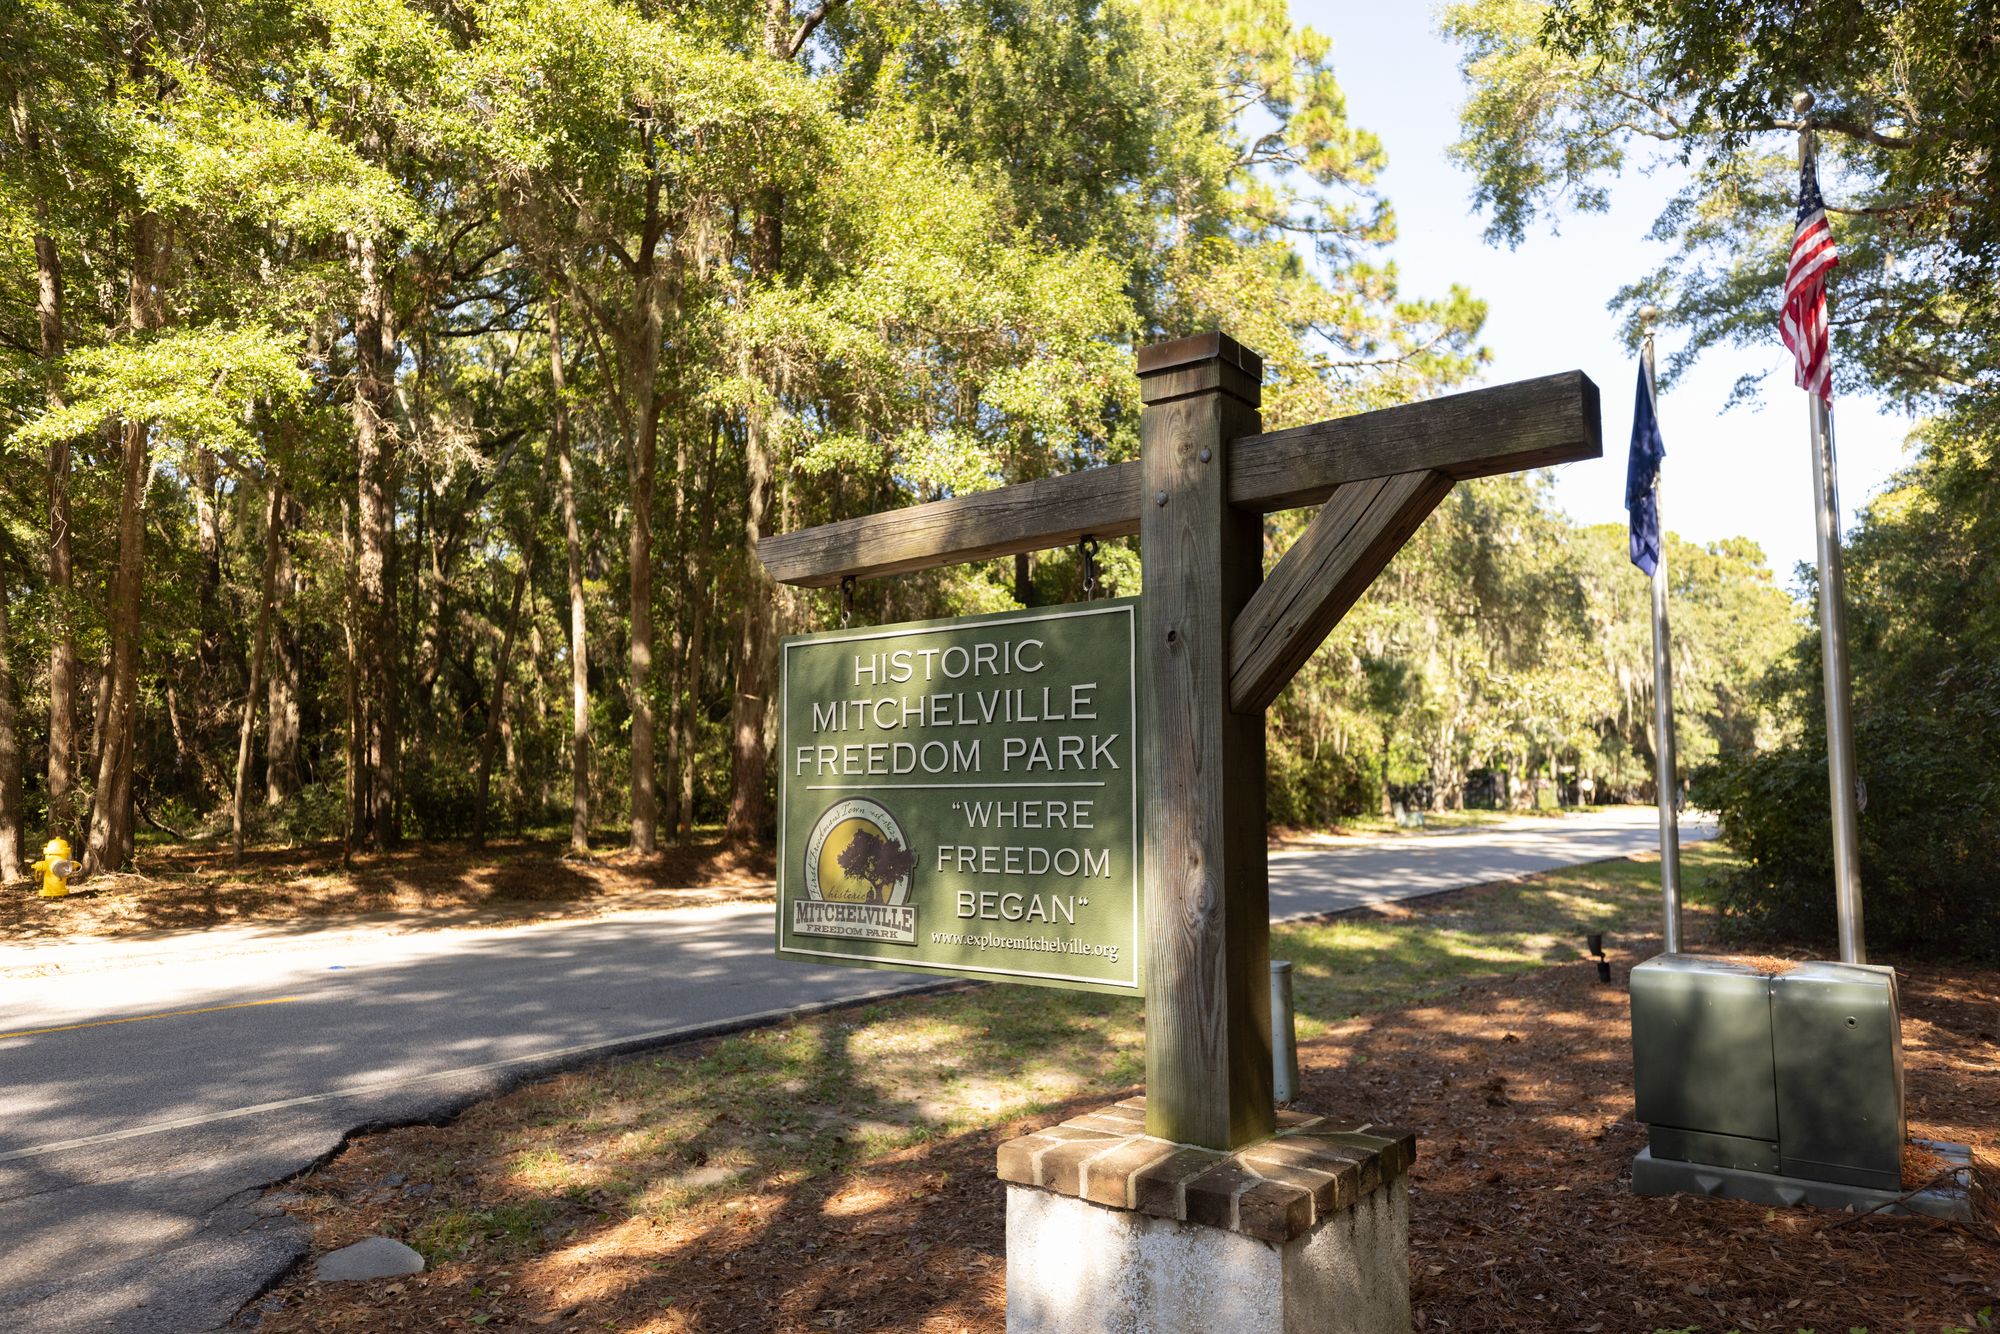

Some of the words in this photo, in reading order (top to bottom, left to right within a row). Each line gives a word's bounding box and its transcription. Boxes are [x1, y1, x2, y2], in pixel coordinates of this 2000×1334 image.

[854, 639, 1044, 686] HISTORIC
[812, 682, 1097, 733] MITCHELVILLE
[796, 739, 981, 776] FREEDOM
[1003, 734, 1120, 771] PARK
[937, 846, 1111, 878] FREEDOM
[827, 886, 866, 900] historic
[796, 901, 913, 933] MITCHELVILLE
[806, 923, 863, 936] FREEDOM
[865, 928, 898, 939] PARK
[931, 931, 1120, 963] www.exploremitchelville.org
